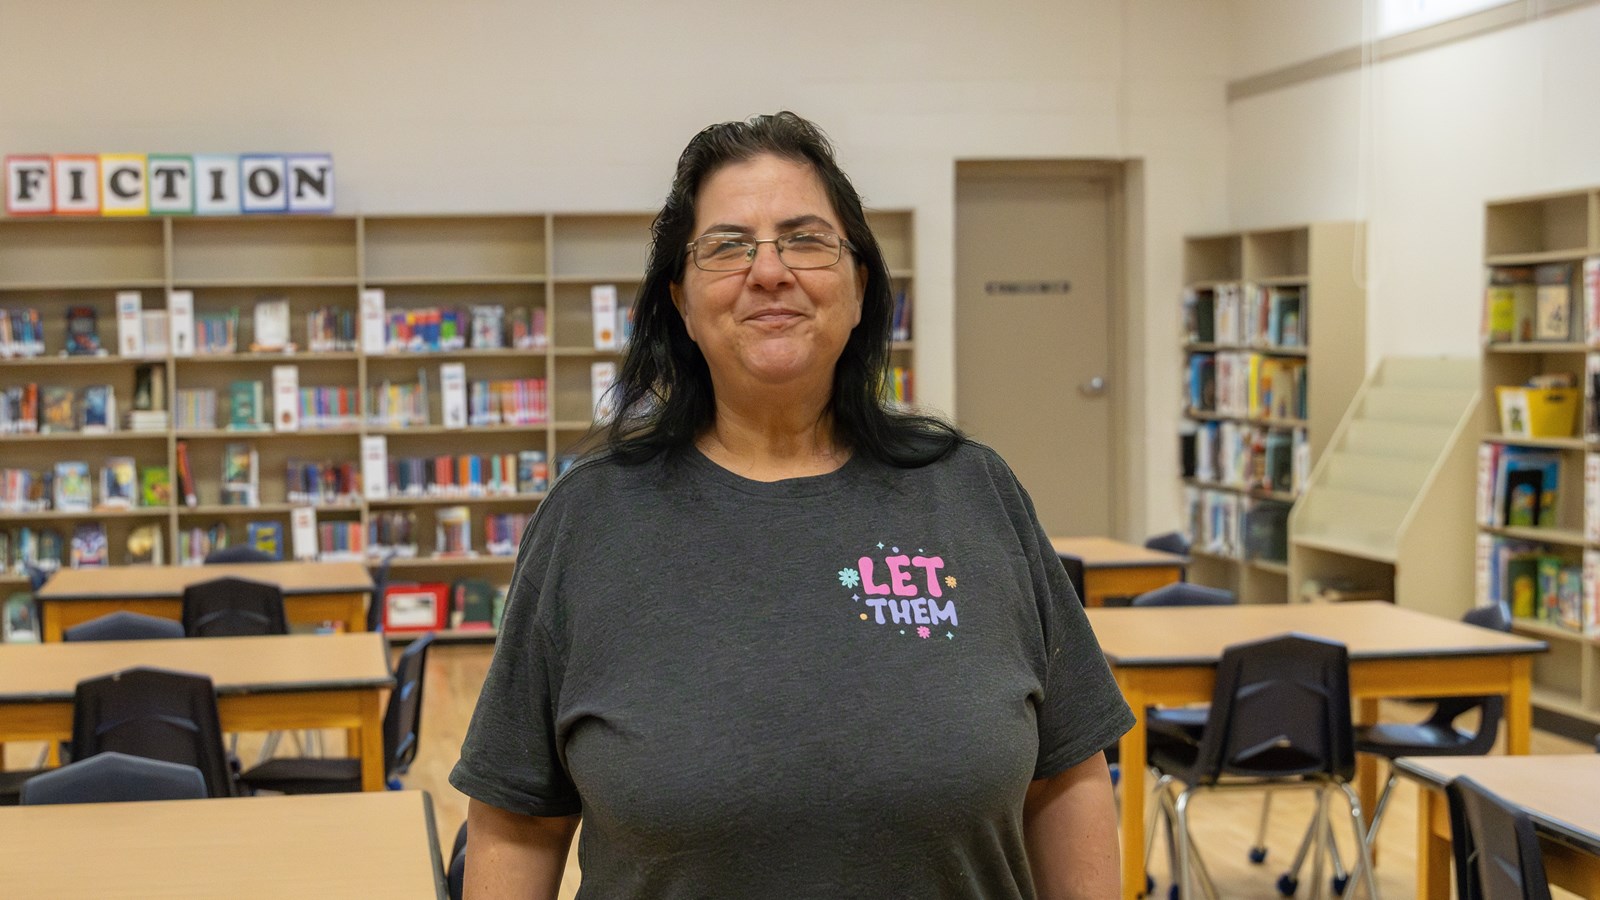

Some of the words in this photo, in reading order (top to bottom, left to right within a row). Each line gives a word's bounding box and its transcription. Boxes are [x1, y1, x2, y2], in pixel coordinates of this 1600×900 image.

[16, 167, 331, 201] FICTION
[858, 554, 945, 598] LET
[865, 597, 959, 627] THEM
